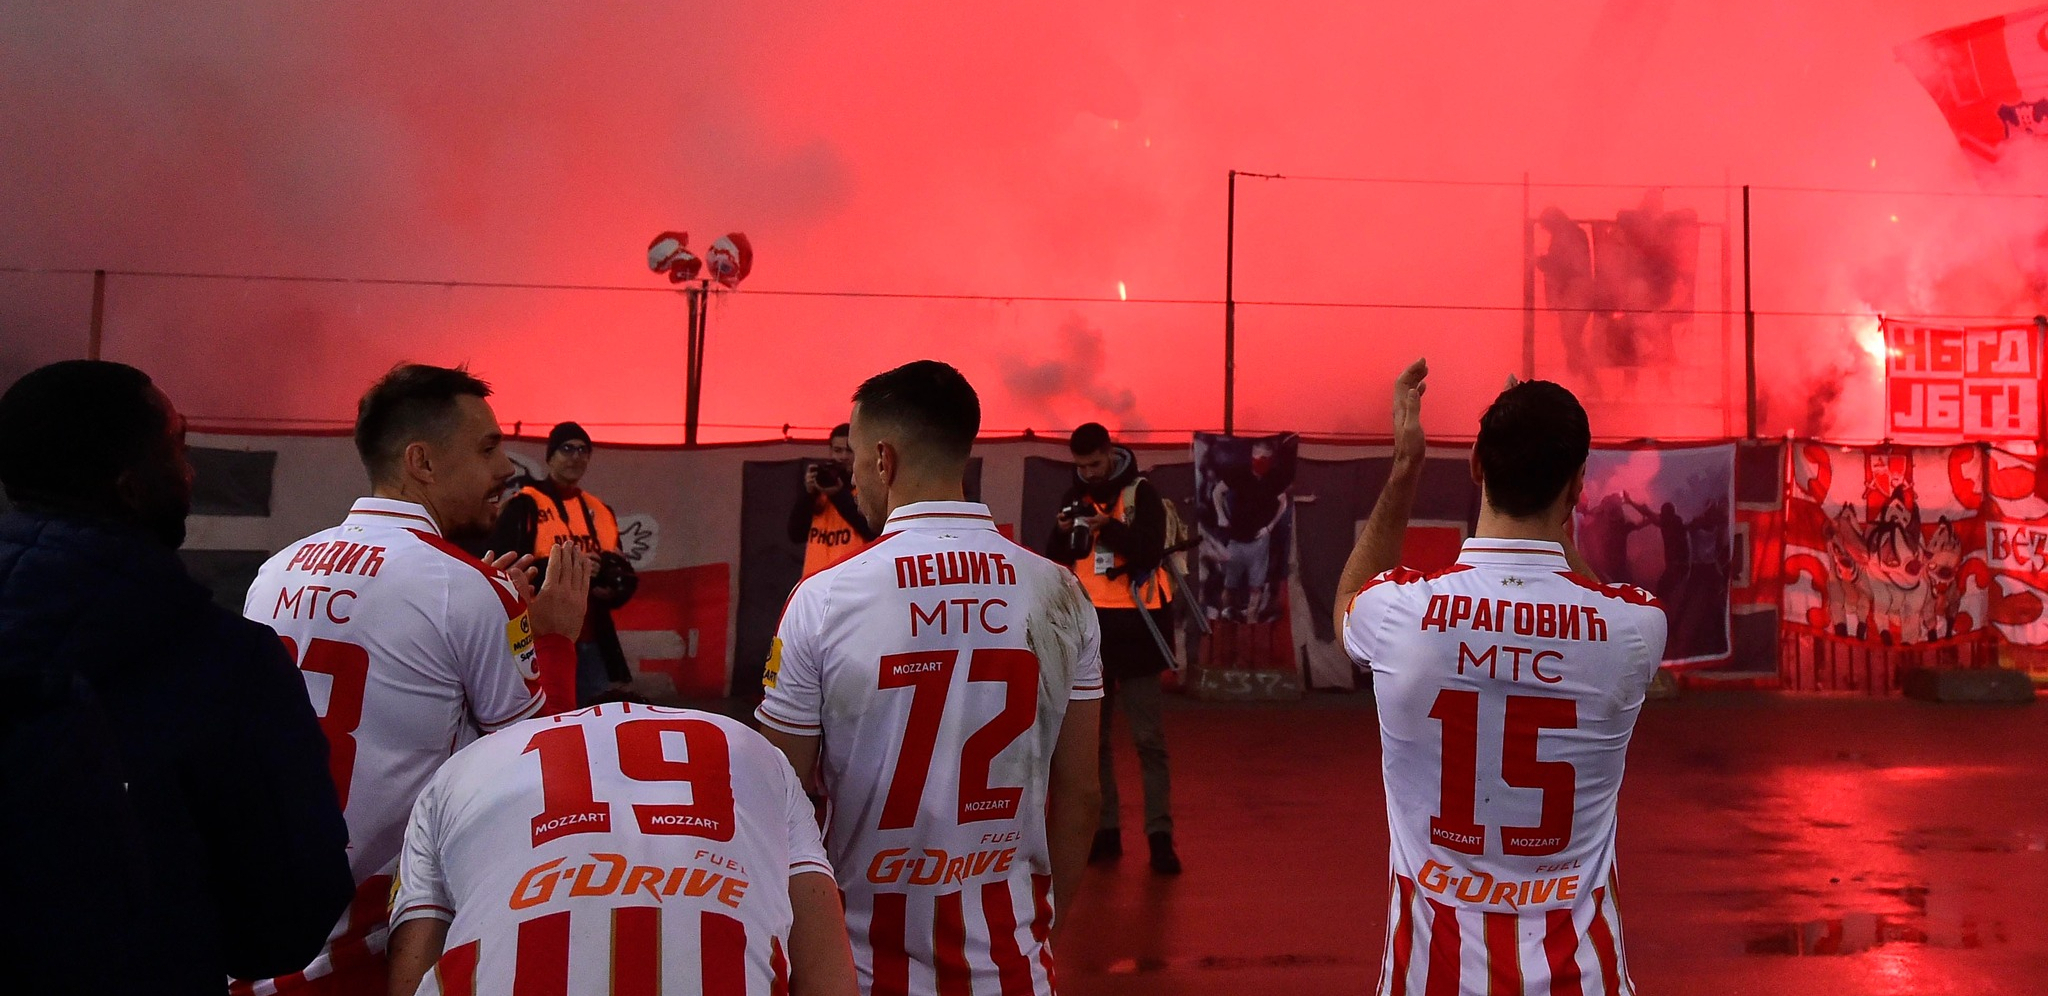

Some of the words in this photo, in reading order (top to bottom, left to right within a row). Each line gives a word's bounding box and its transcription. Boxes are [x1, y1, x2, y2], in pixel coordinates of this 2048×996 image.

[809, 527, 852, 546] PHOTO
[286, 541, 387, 578] РОДИЋ
[894, 551, 1017, 589] ПЕШИЋ
[1420, 594, 1608, 642] ДРАГОВИЋ
[893, 661, 943, 675] MOZZART
[877, 648, 1040, 831] 72
[1427, 688, 1578, 856] 15
[522, 718, 735, 849] 19
[964, 799, 1011, 812] MOZZART
[535, 812, 607, 836] MOZZART
[651, 815, 720, 831] MOZZART
[981, 830, 1021, 845] FUEL
[1432, 827, 1482, 845] MOZZART
[1510, 837, 1561, 846] MOZZART
[694, 850, 749, 877] FUEL
[1535, 859, 1581, 873] FUEL
